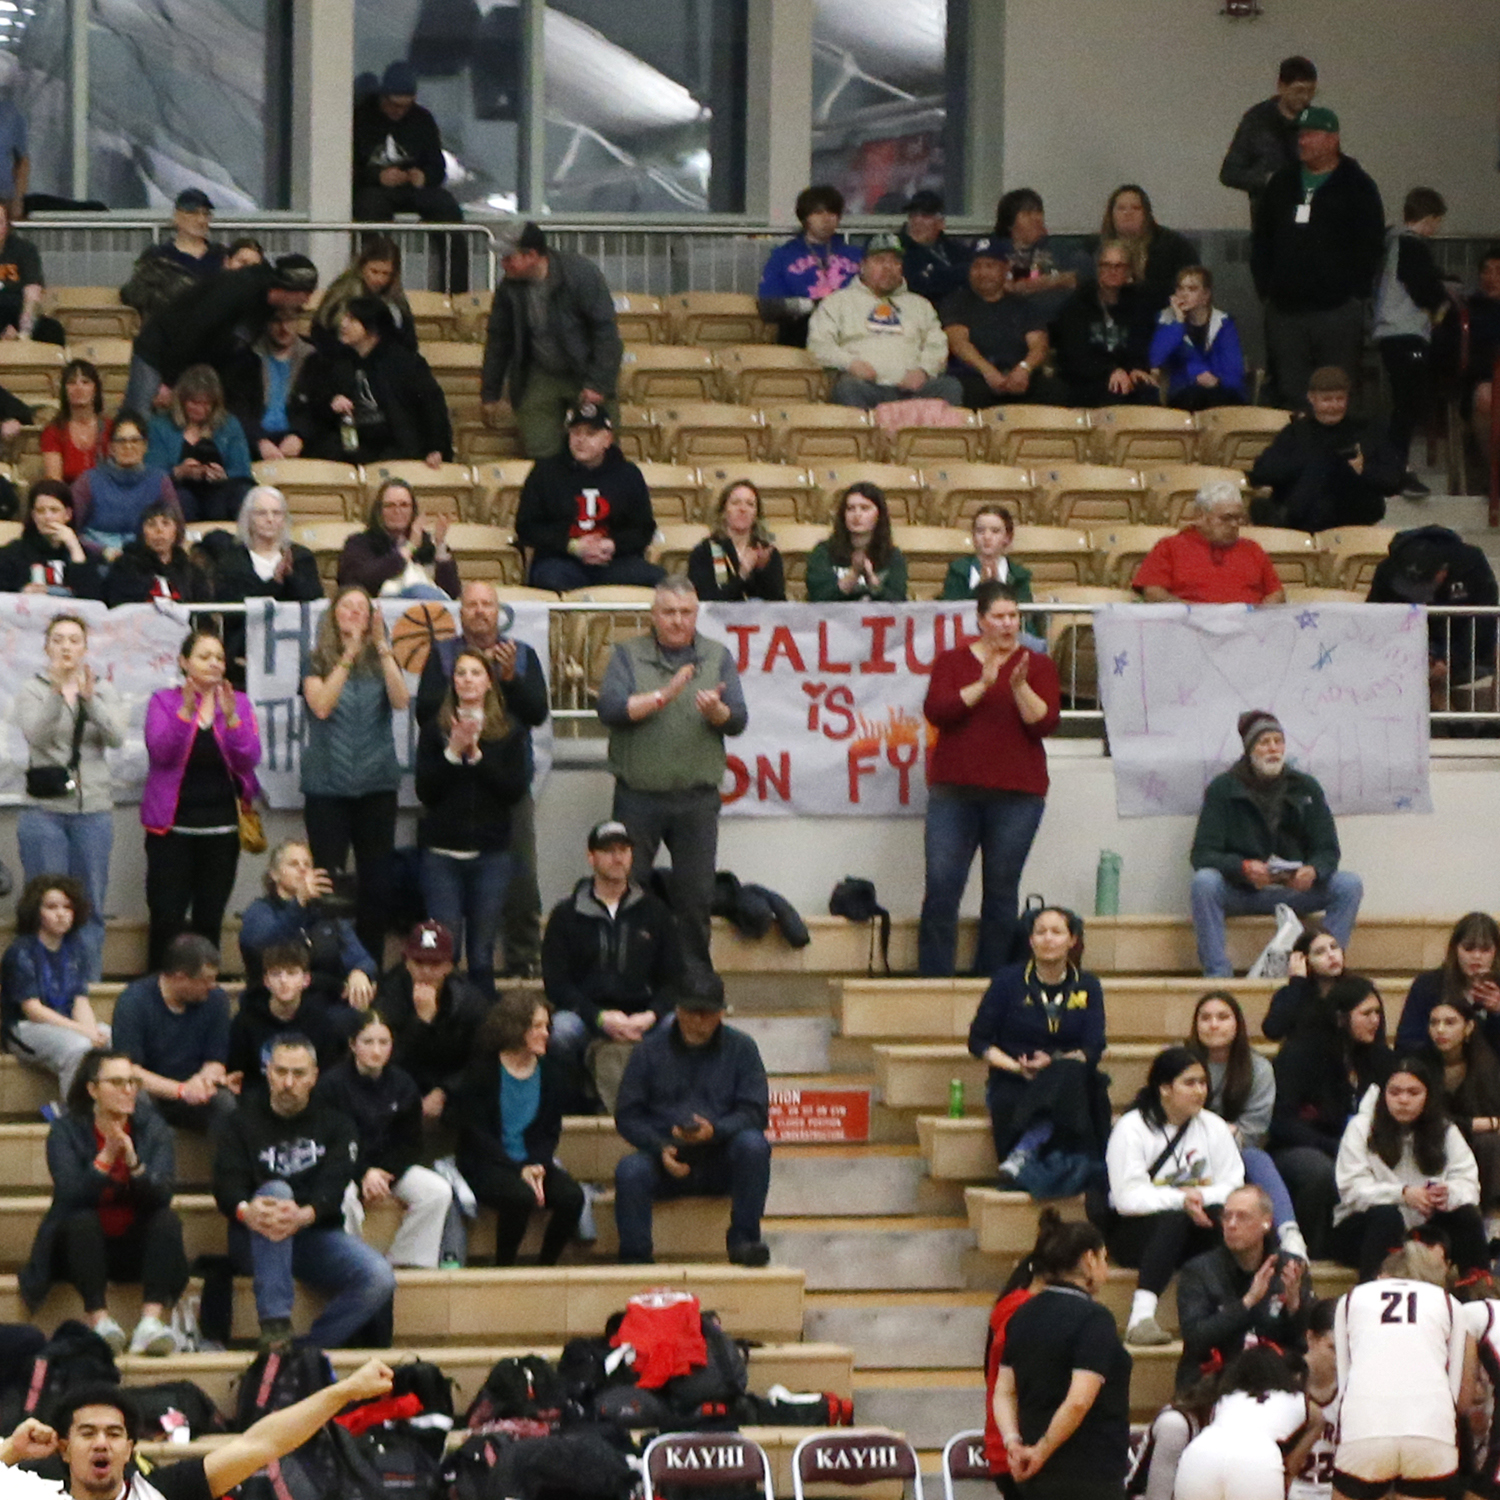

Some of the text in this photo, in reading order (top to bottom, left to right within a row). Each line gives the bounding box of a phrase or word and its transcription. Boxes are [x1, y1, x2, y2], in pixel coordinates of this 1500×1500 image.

[1381, 1291, 1418, 1325] 21
[666, 1445, 745, 1470] KAYHI
[816, 1446, 898, 1470] KAYHI
